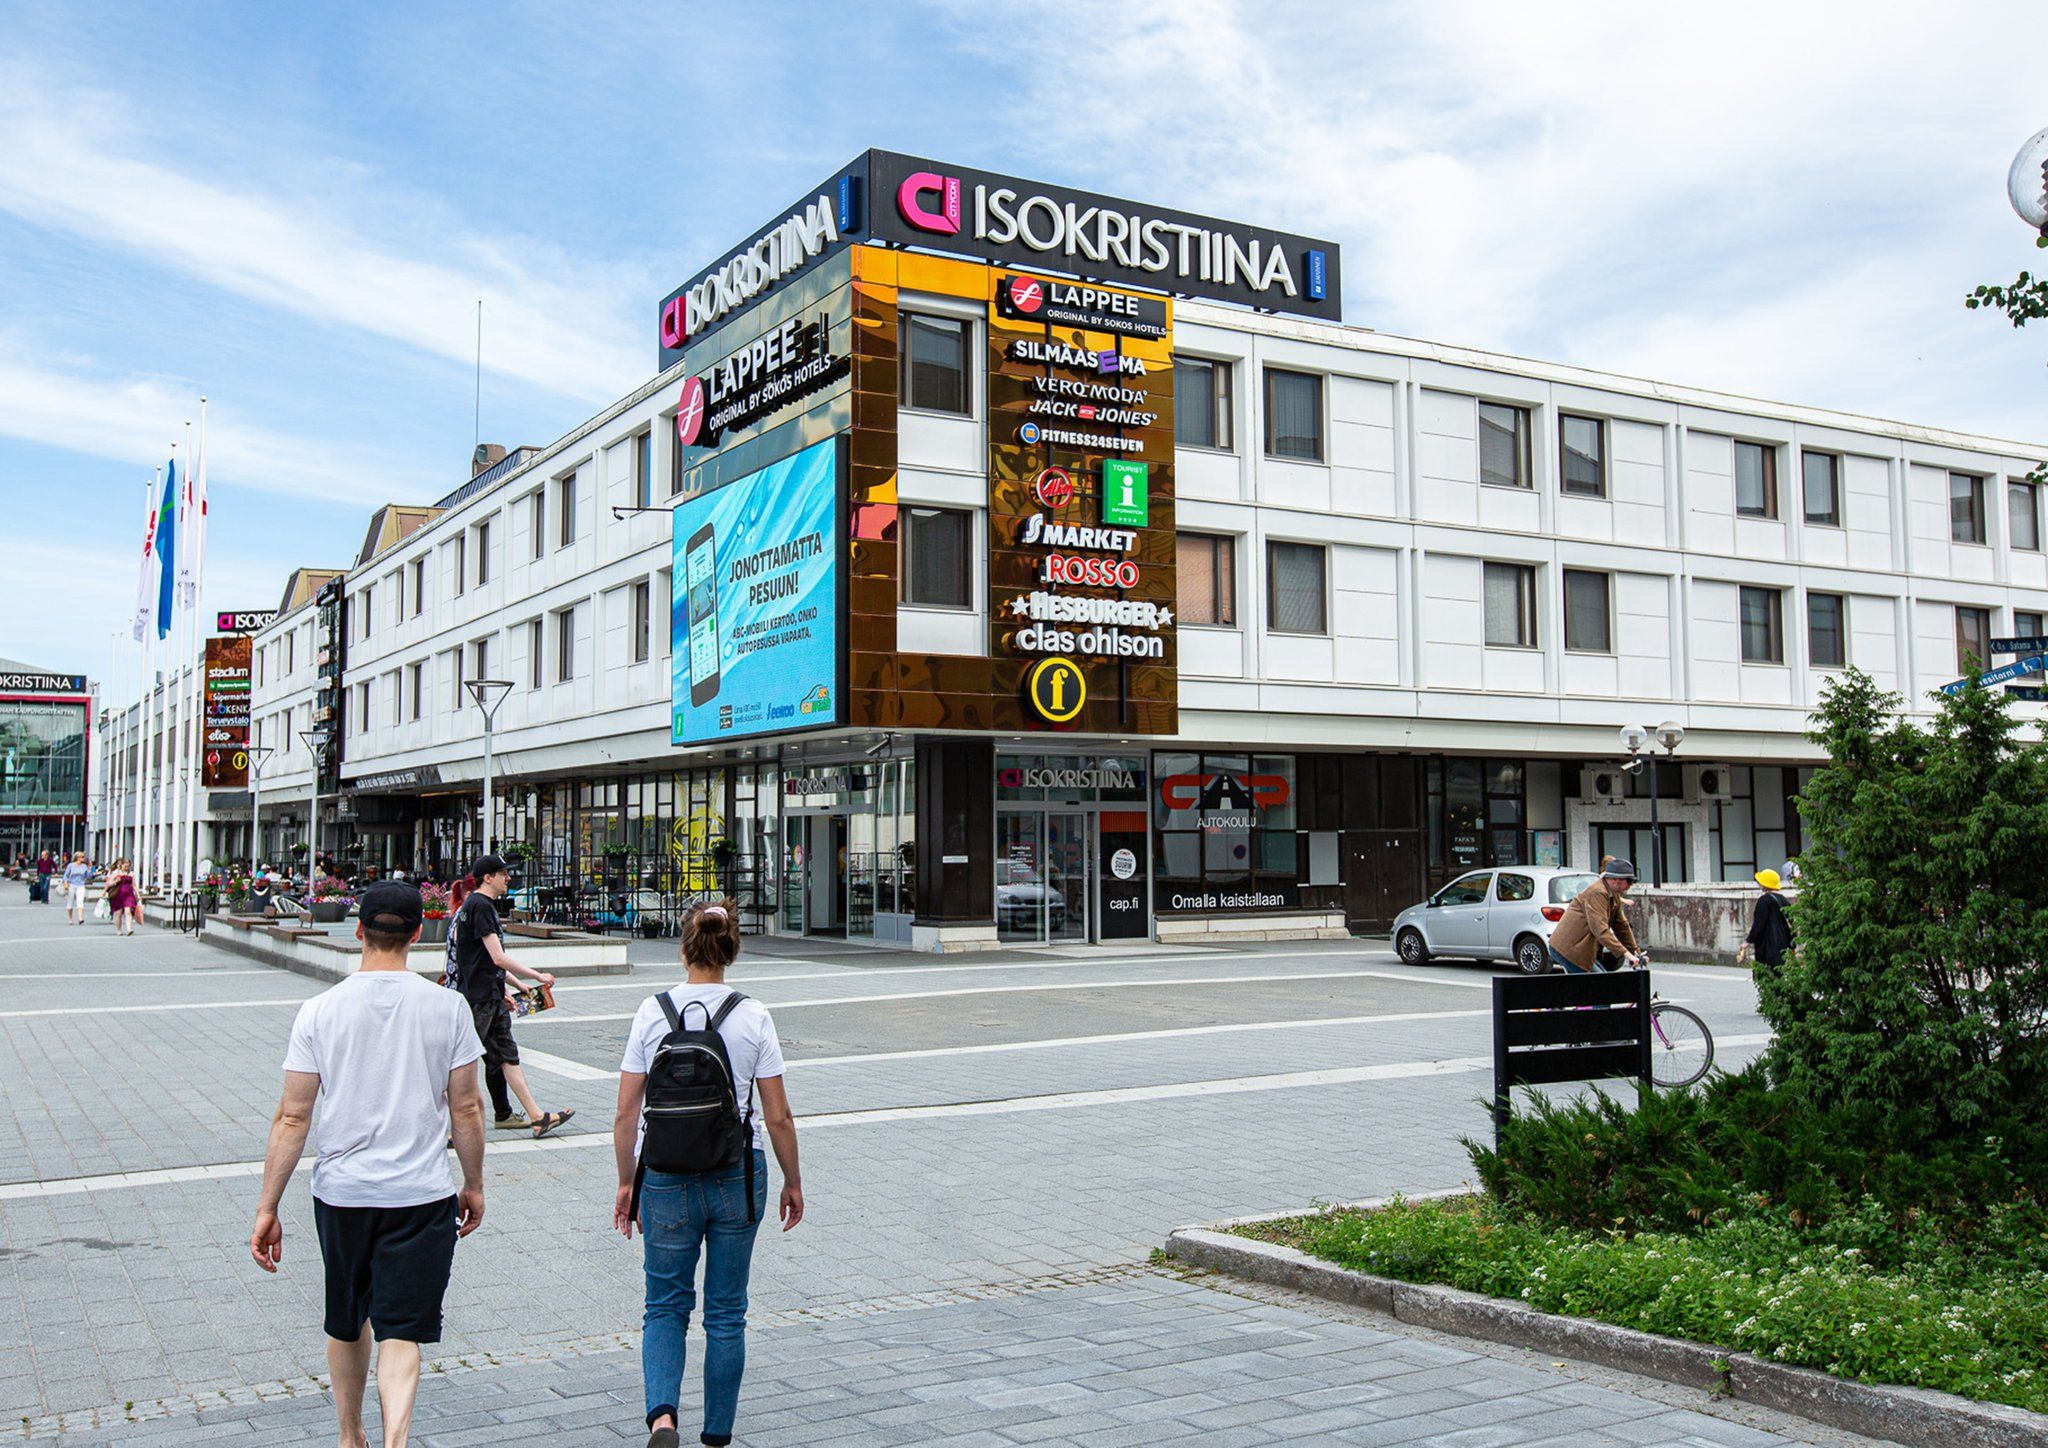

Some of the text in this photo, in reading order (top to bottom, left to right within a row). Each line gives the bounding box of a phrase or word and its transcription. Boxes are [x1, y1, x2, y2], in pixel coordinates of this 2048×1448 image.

[949, 181, 957, 217] CITYCON
[974, 184, 1298, 298] ISOKRISTIINA
[685, 194, 839, 336] ISOKRISTIINA
[1051, 282, 1139, 316] LAPPEE
[1047, 309, 1167, 336] ORIGINAL BY SOKOS HOTELS
[710, 319, 799, 405] LAPPEE
[1015, 340, 1147, 375] SILMÄASEMA
[709, 353, 831, 431] ORIGINAL BY SOKOS HOTELS
[1035, 376, 1086, 395] VERO
[1029, 399, 1078, 418] JACK
[1041, 429, 1144, 452] FITNESS24SEVEN
[1112, 464, 1143, 474] TOURIST
[1043, 524, 1137, 551] MARKET
[729, 532, 823, 583] JONOTTAMATTA
[1045, 554, 1139, 588] ROSSO
[749, 570, 799, 607] PESUUN!
[733, 606, 818, 639] ABC-MOBIILI KERTOO, ONKO
[1030, 591, 1159, 630] HESBURGER
[737, 627, 812, 655] AUTOPESUSSA VAPAATA.
[1016, 623, 1164, 658] clas ohlson
[208, 666, 249, 677] stadium
[206, 717, 250, 726] Terveystalo
[1022, 769, 1136, 788] ISOKRISTIINA
[1196, 817, 1257, 828] AUTOKOULU
[1110, 897, 1139, 912] cap.fi
[1172, 892, 1285, 909] Omalla kaistallaan
